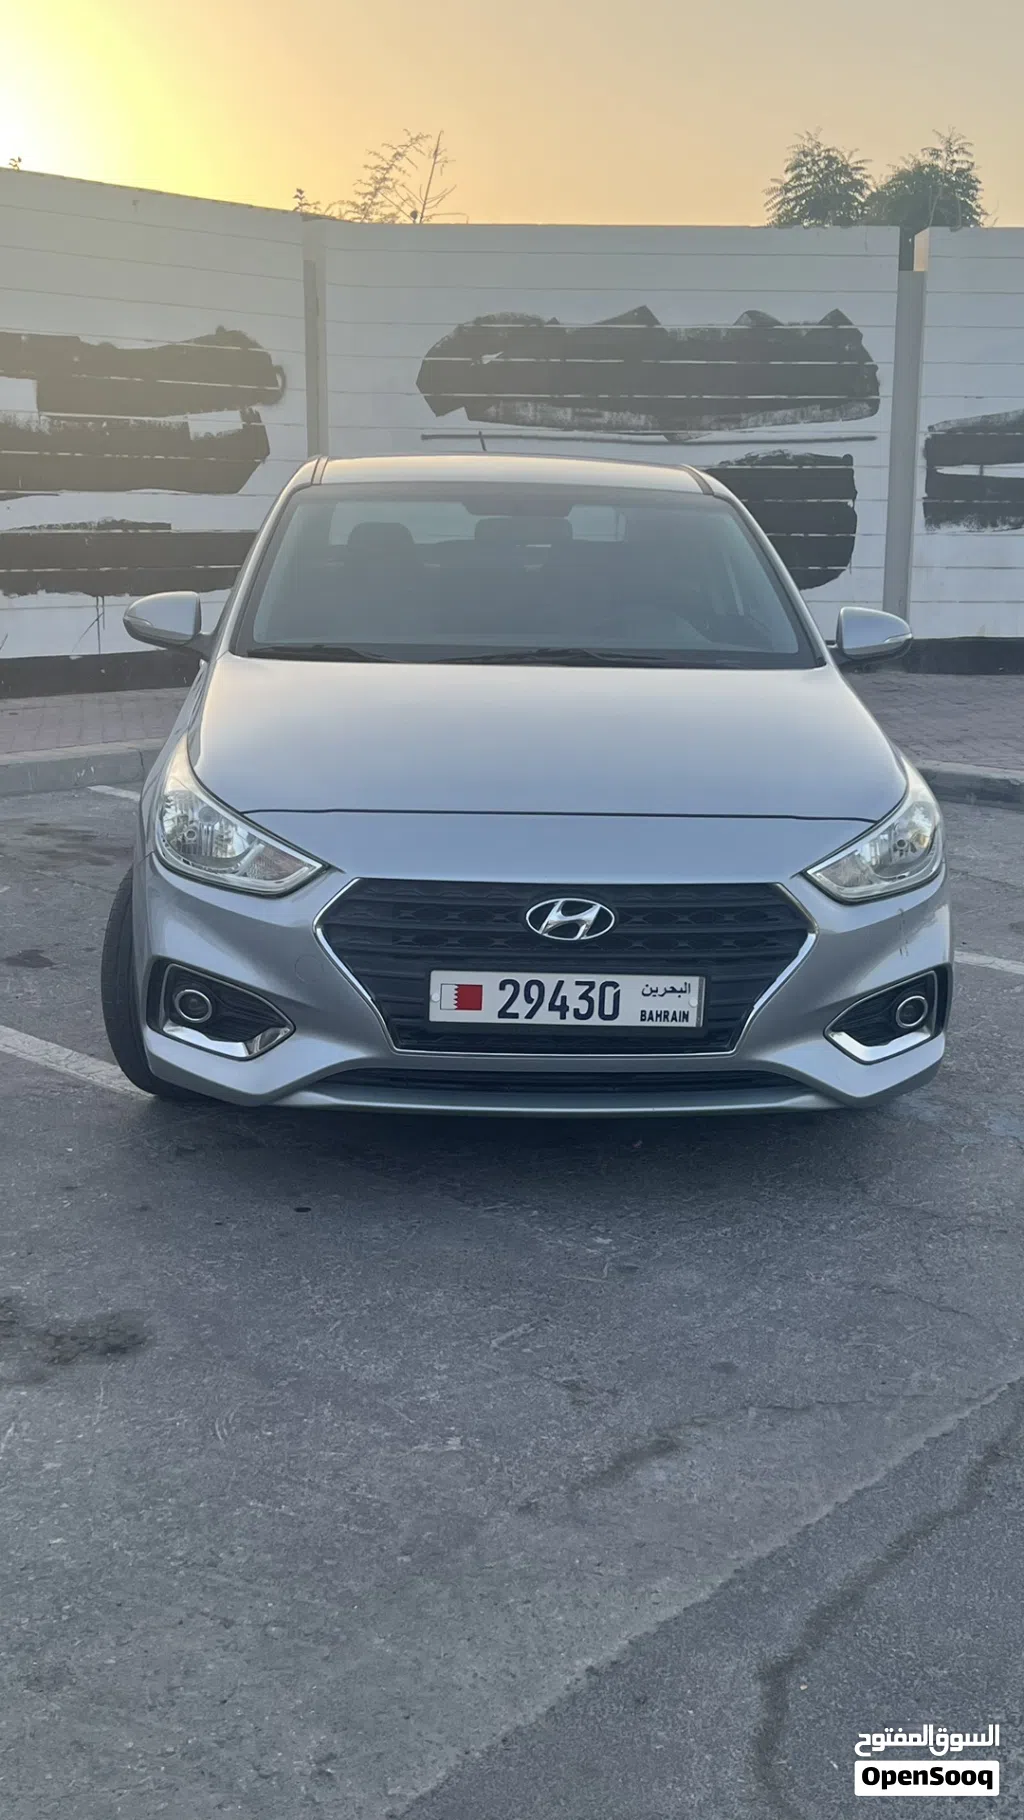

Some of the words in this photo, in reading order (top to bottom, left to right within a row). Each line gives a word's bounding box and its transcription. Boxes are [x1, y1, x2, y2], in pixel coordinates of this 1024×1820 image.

[641, 981, 691, 998] البحرين
[497, 979, 621, 1021] 29430
[640, 1009, 690, 1022] BAHRAIN
